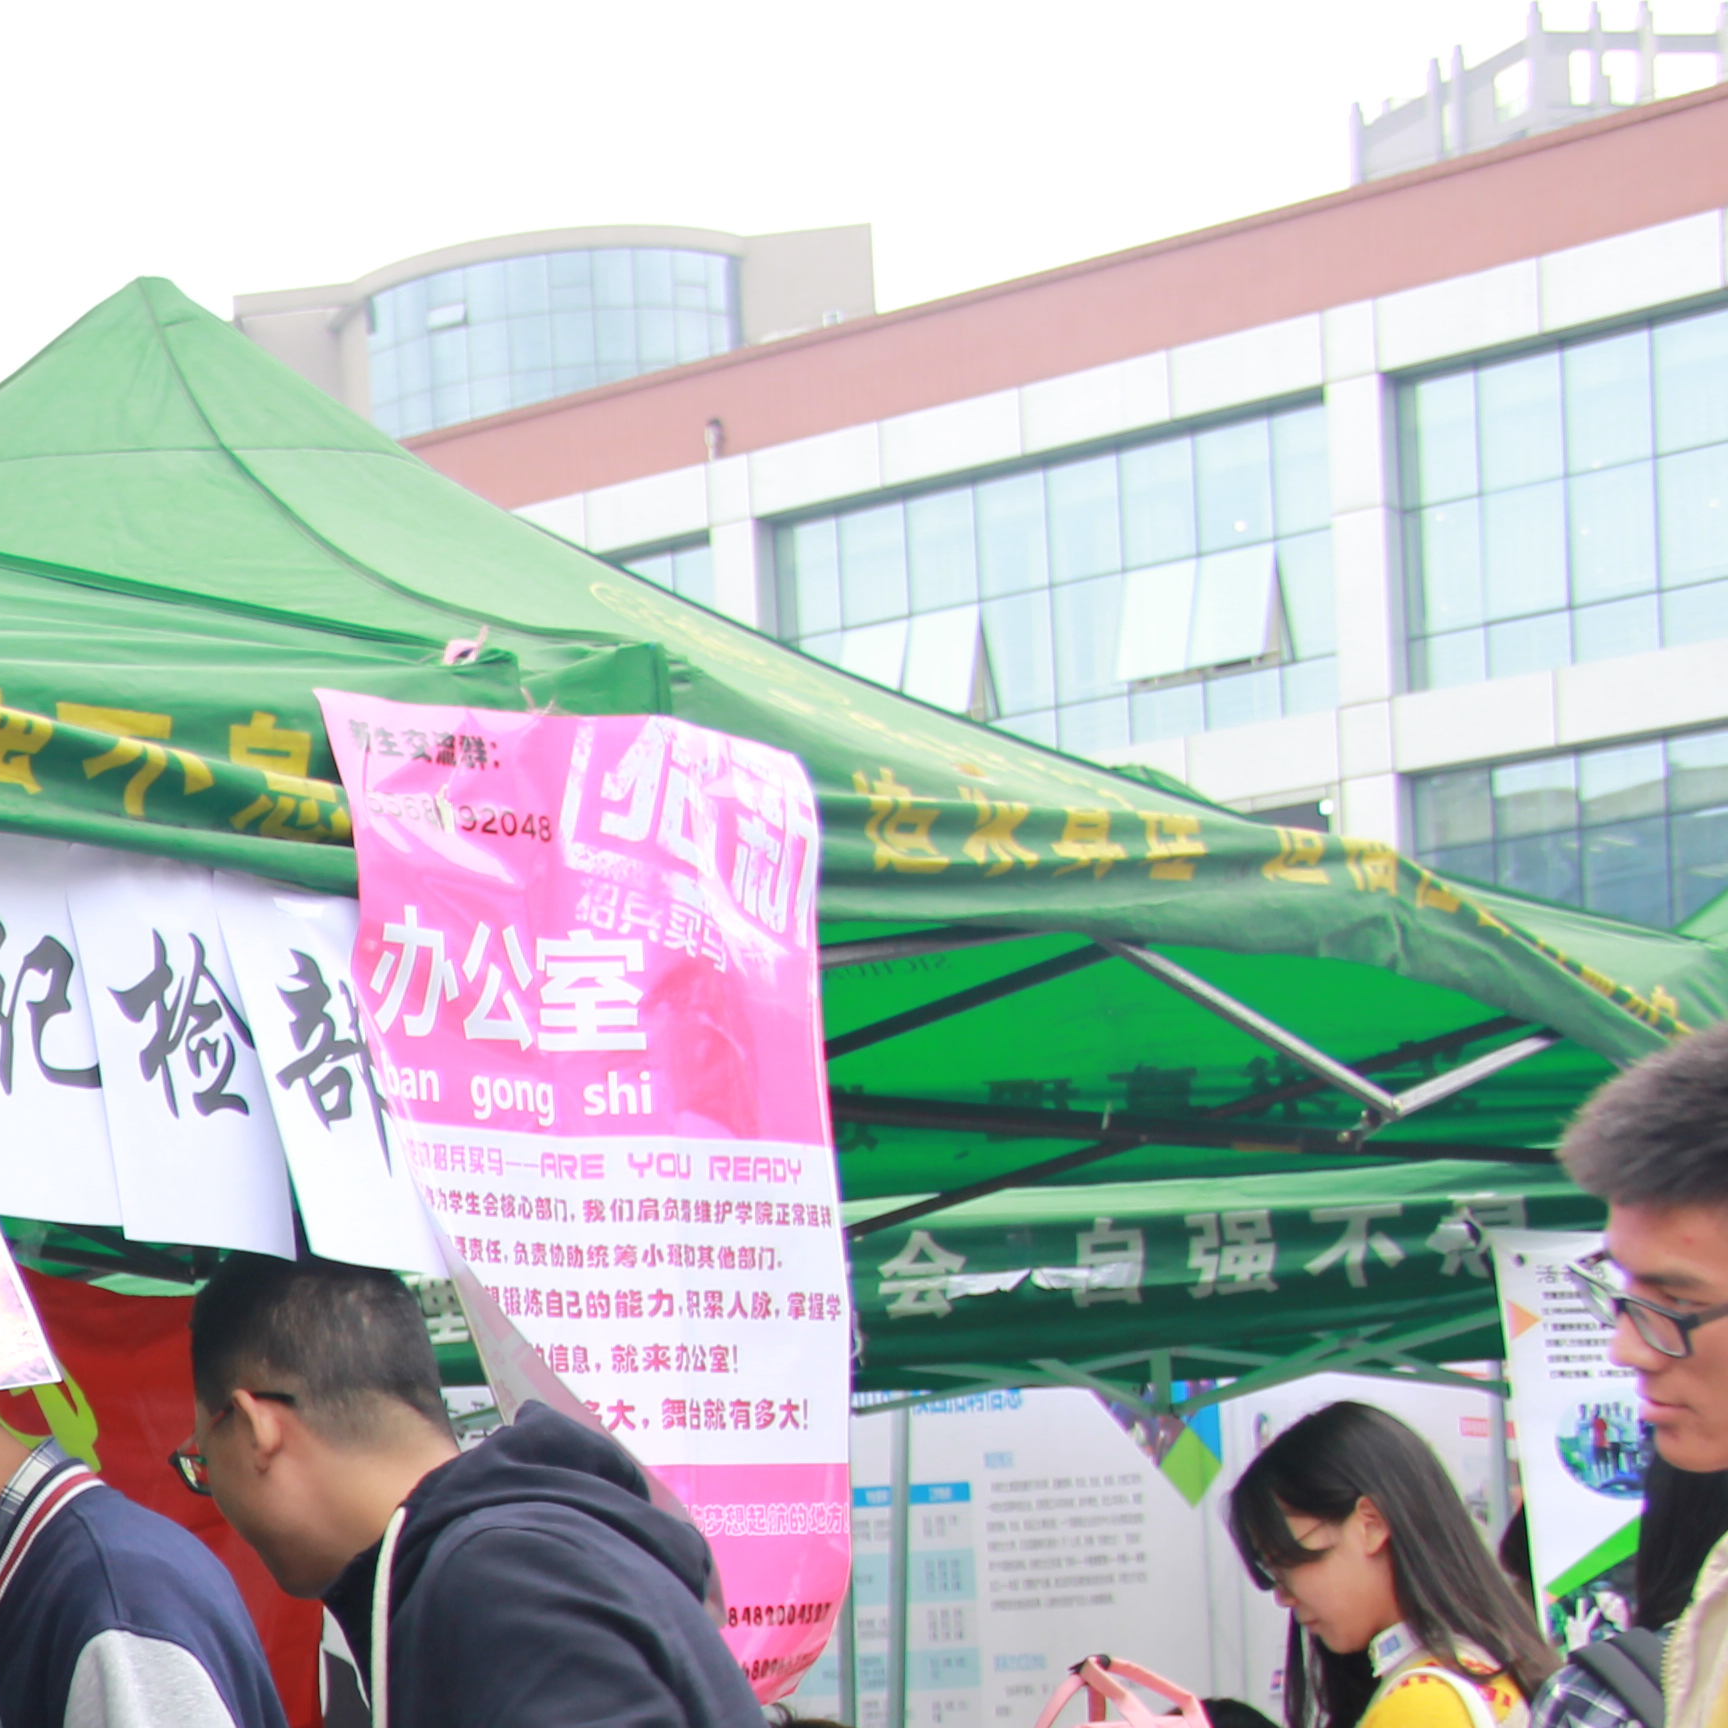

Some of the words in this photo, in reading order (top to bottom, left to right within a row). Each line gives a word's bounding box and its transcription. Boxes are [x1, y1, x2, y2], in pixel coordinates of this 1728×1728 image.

[368, 904, 648, 1053] 办公室
[382, 1051, 440, 1103] ban
[470, 1071, 555, 1126] gong
[583, 1070, 654, 1116] shi
[627, 1152, 692, 1181] YOU
[708, 1154, 803, 1184] READY
